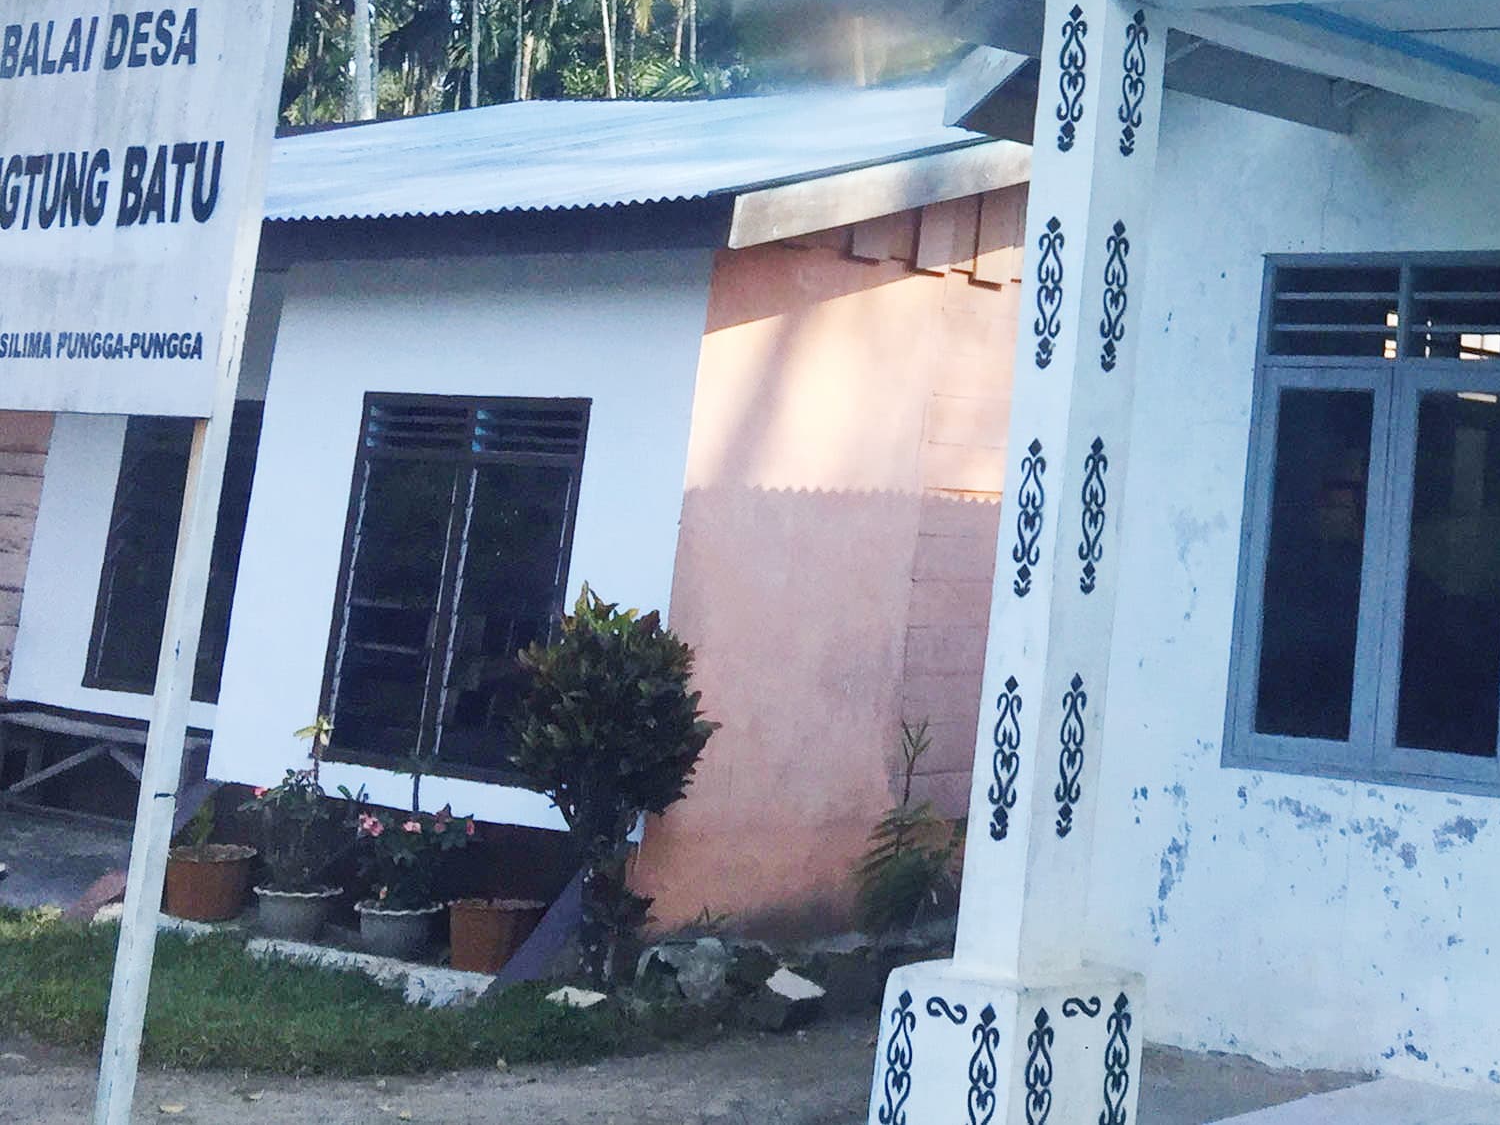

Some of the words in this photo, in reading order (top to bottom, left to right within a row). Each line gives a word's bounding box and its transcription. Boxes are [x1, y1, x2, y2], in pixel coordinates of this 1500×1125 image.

[0, 16, 99, 79] BALAI
[103, 8, 197, 70] DESA
[0, 148, 110, 230] GTUNG
[116, 141, 225, 227] BATU
[0, 332, 51, 359] SILIMA
[56, 332, 203, 360] PUNGGA-PUNGGA
